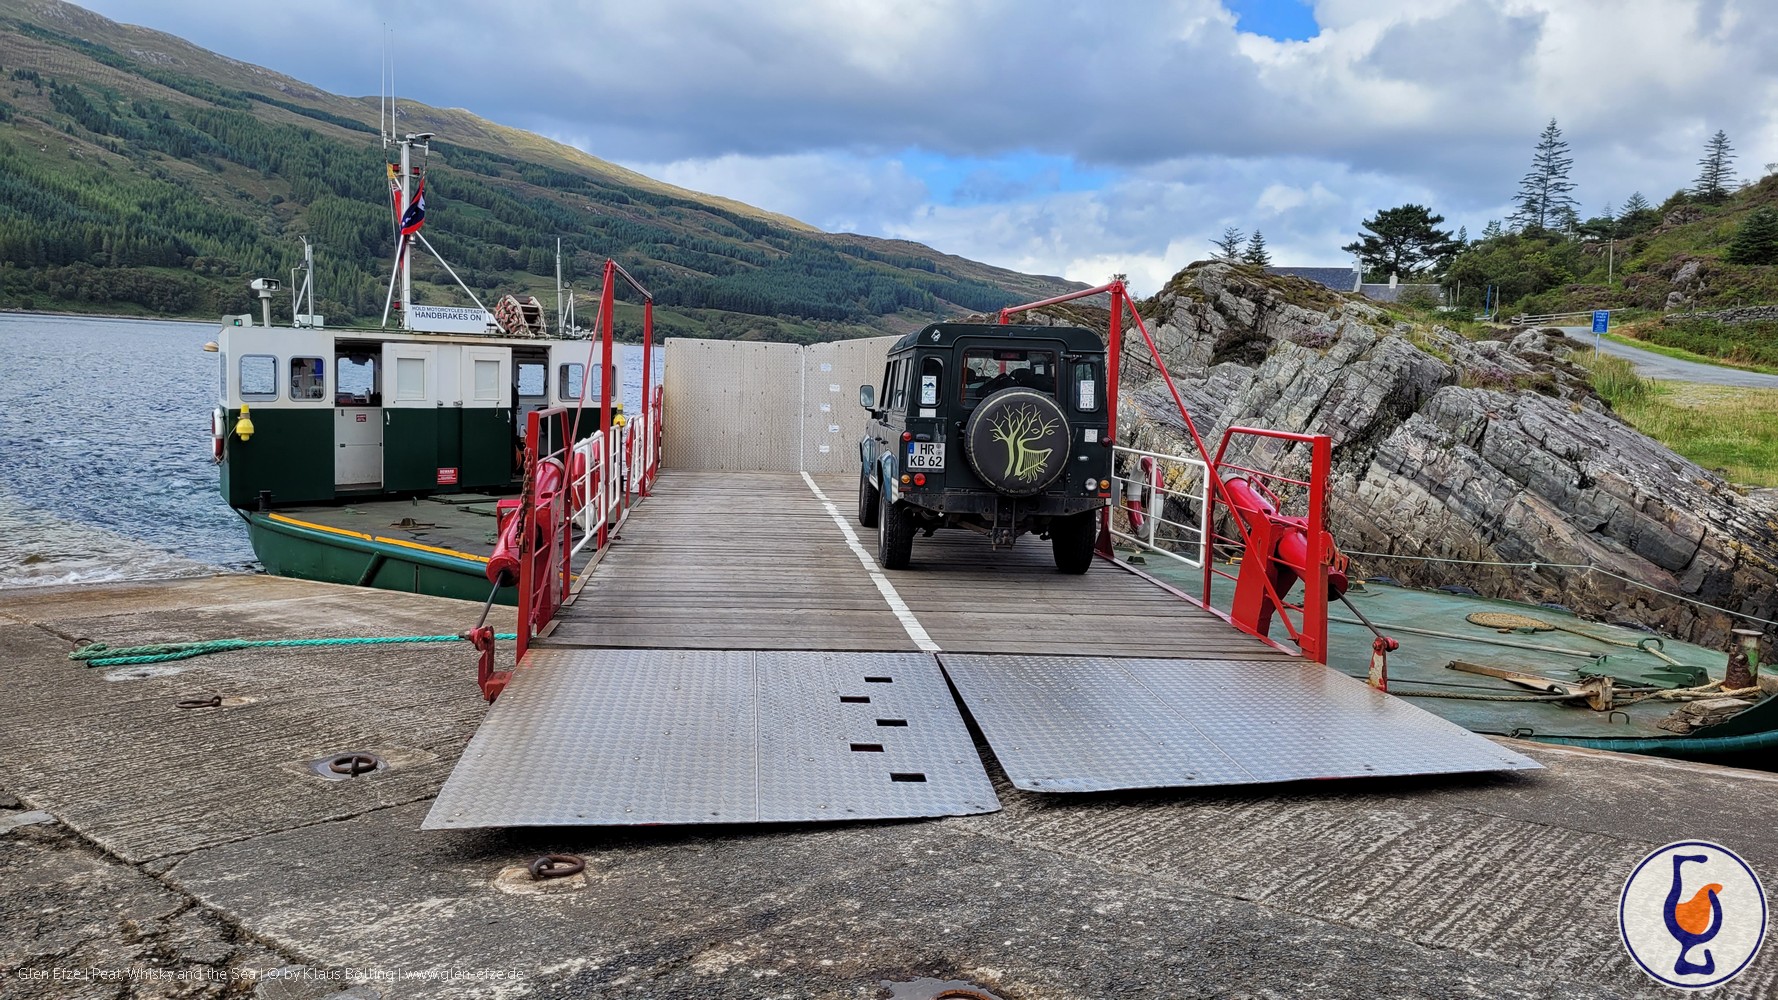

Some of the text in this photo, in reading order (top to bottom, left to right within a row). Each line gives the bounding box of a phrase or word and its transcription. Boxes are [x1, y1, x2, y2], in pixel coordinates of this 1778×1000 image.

[415, 312, 468, 320] HANDBRAKES
[920, 444, 934, 455] HR
[910, 456, 942, 467] KB 62
